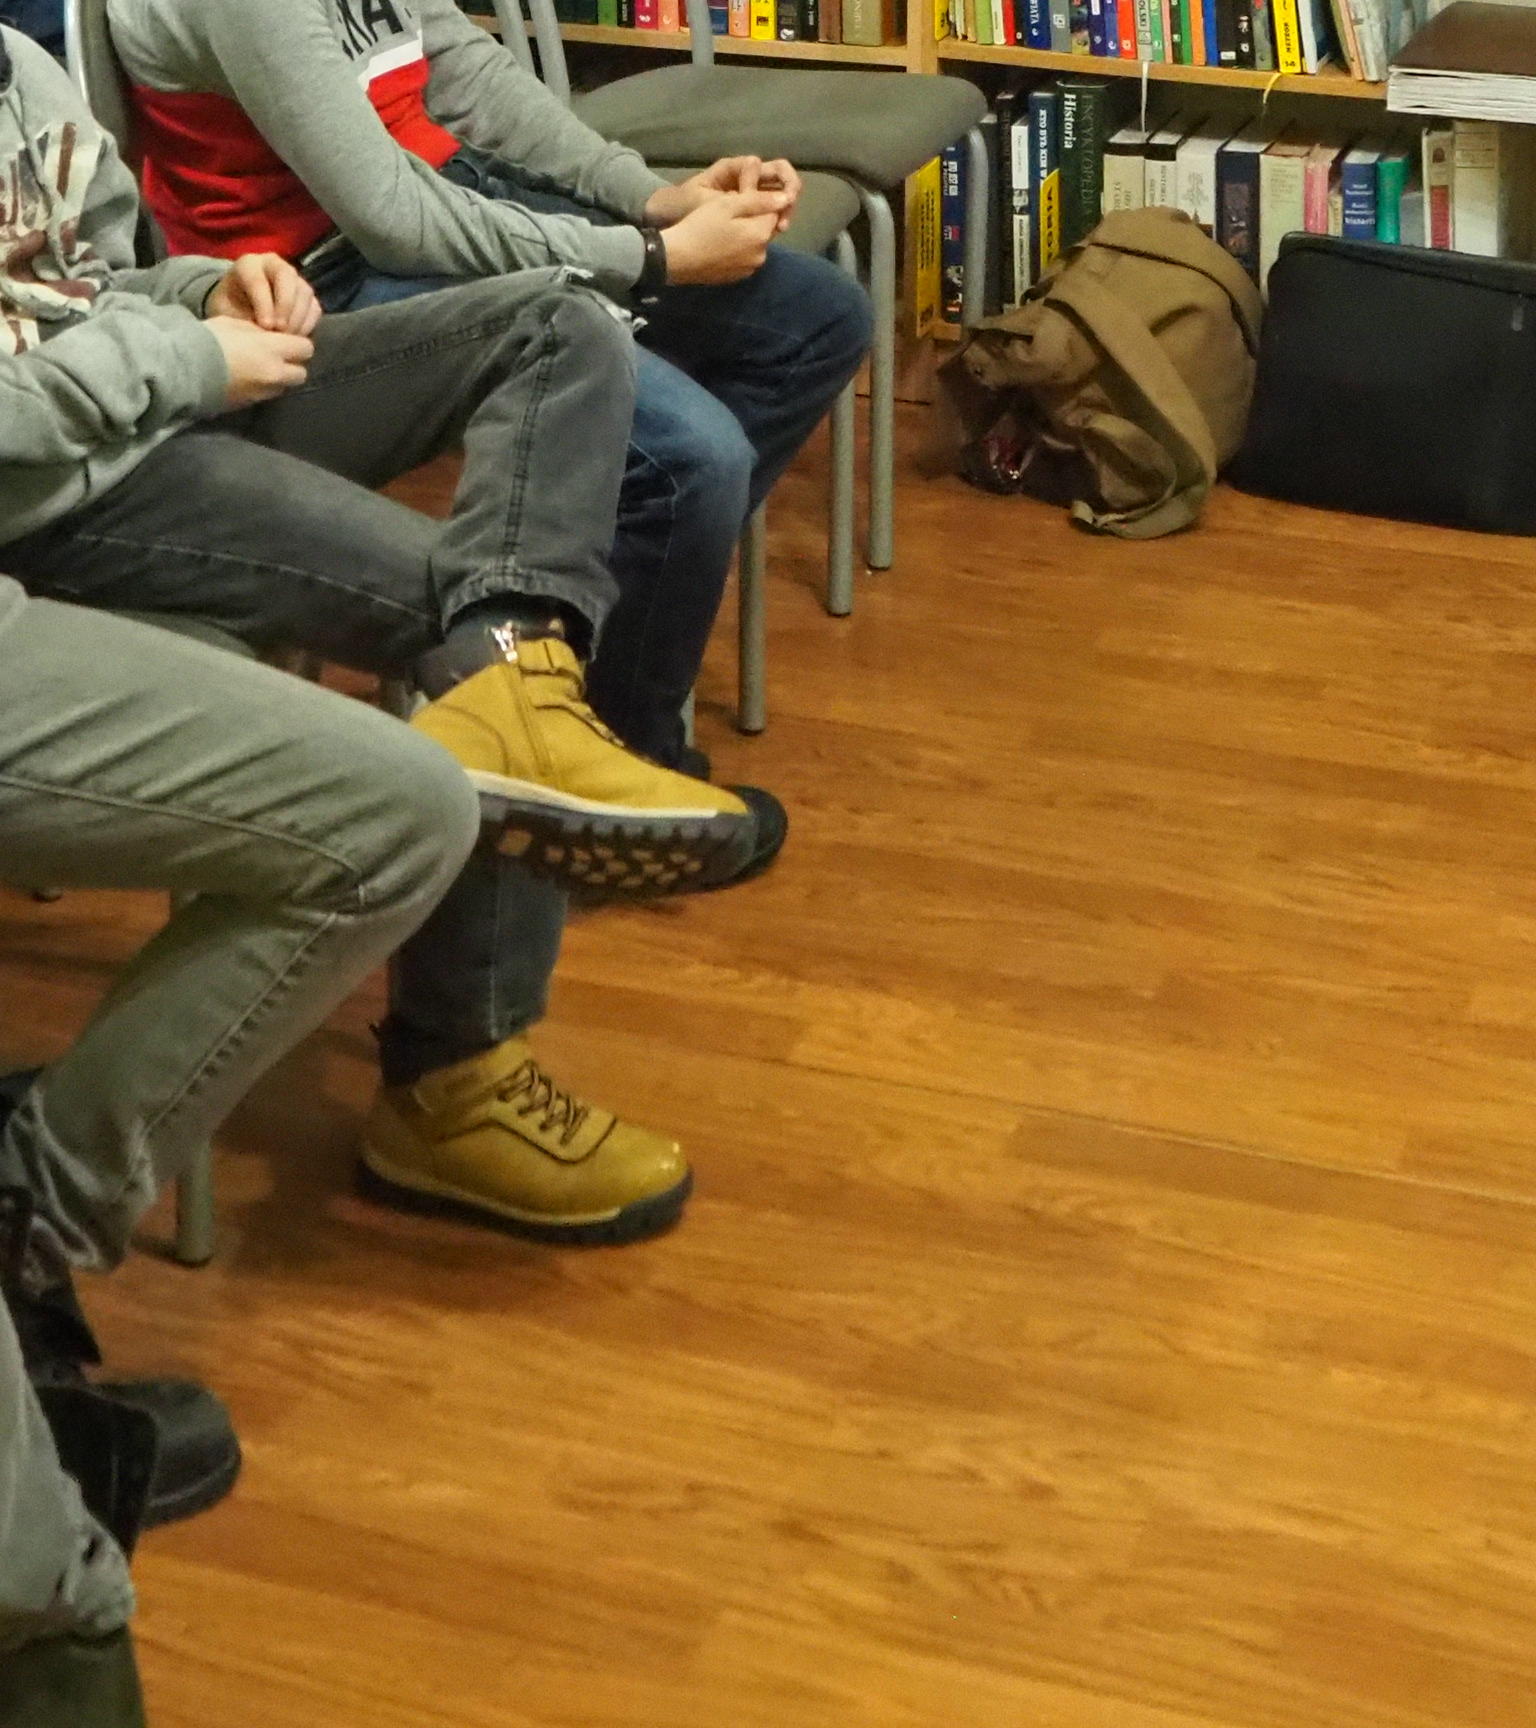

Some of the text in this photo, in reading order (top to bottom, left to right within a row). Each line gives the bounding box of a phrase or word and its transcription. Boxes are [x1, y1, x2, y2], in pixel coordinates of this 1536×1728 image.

[1038, 109, 1049, 168] KTO BYŁ KIM
[1063, 93, 1078, 150] Historia
